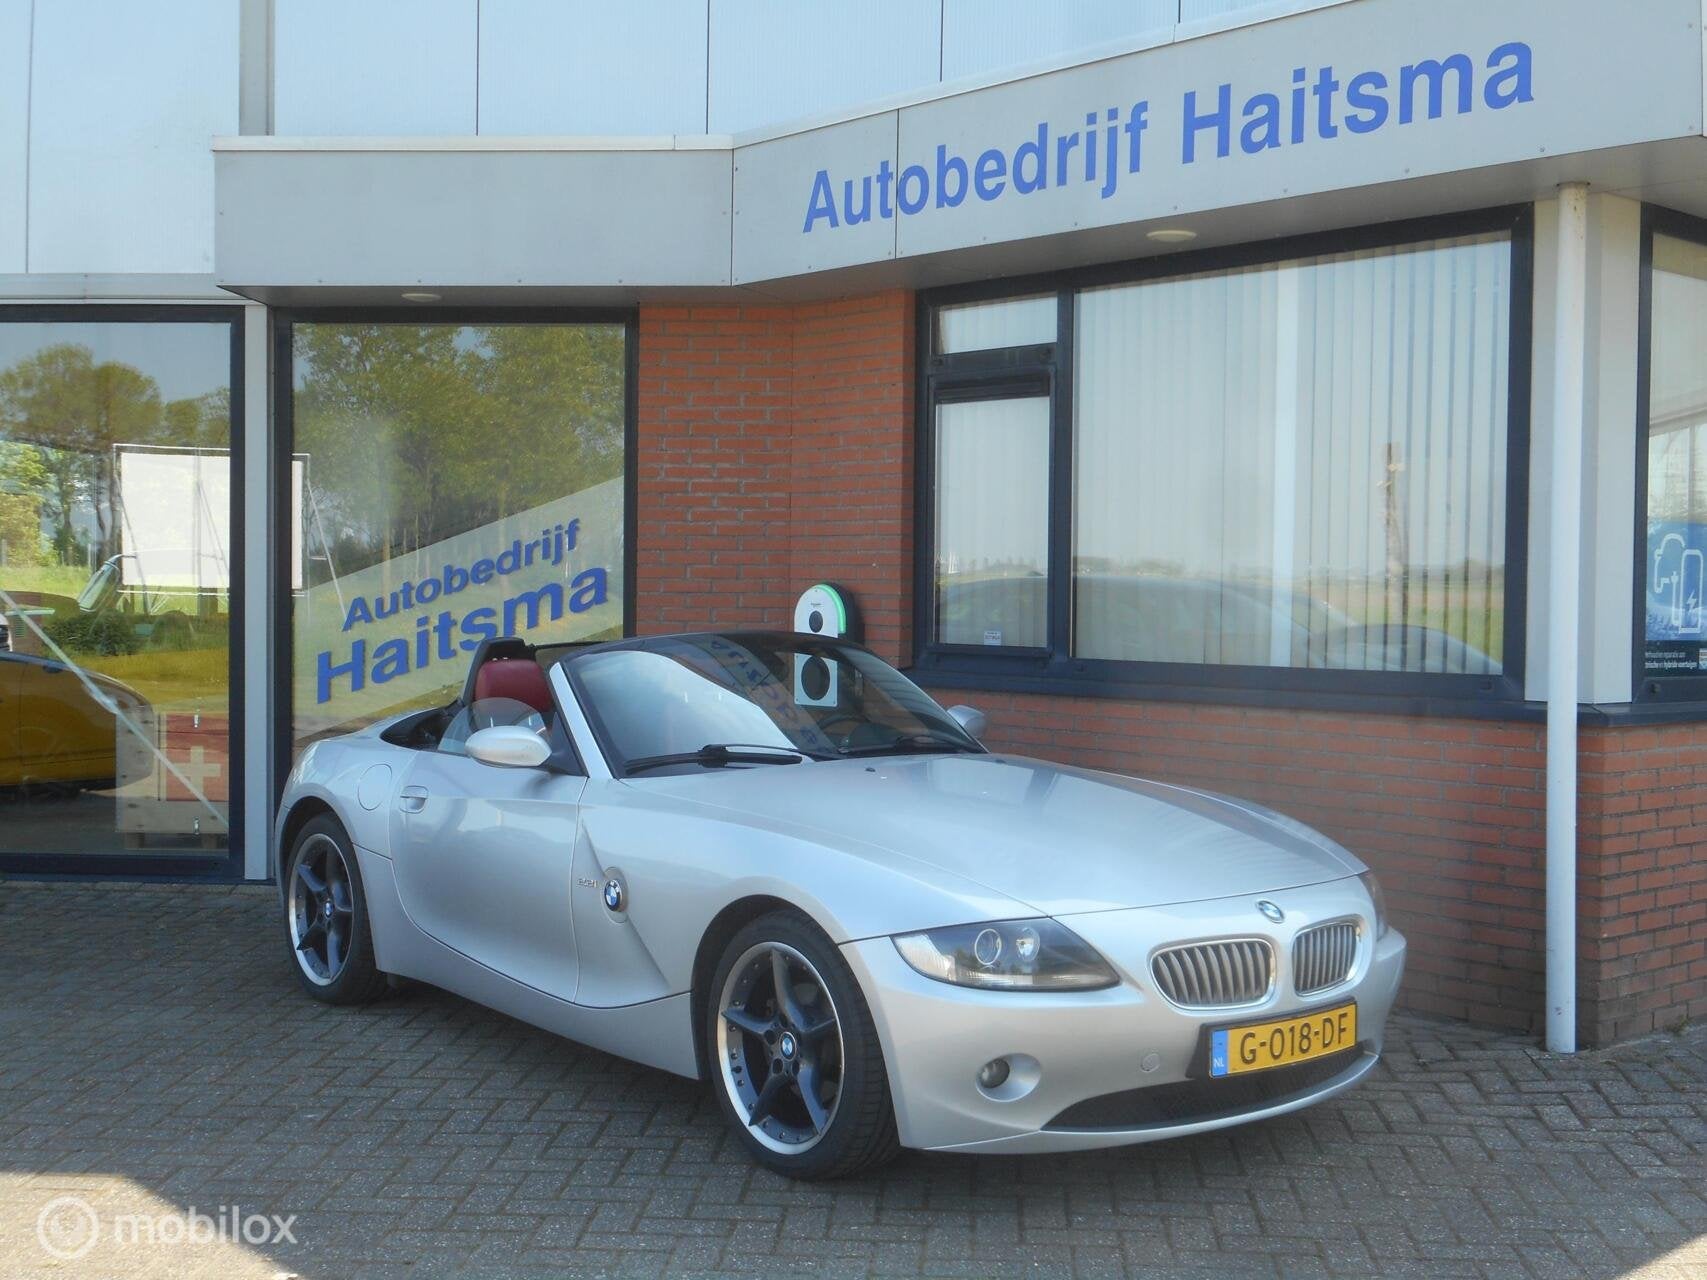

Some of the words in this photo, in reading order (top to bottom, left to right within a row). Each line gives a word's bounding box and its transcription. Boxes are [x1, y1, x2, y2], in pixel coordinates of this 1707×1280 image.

[803, 101, 1149, 233] Autobedrijf
[1182, 42, 1534, 165] Haitsma
[342, 518, 580, 632] Autobedrijf
[317, 567, 608, 704] Haitsma
[1213, 1057, 1225, 1068] NL
[1240, 1012, 1348, 1065] G-018-DF
